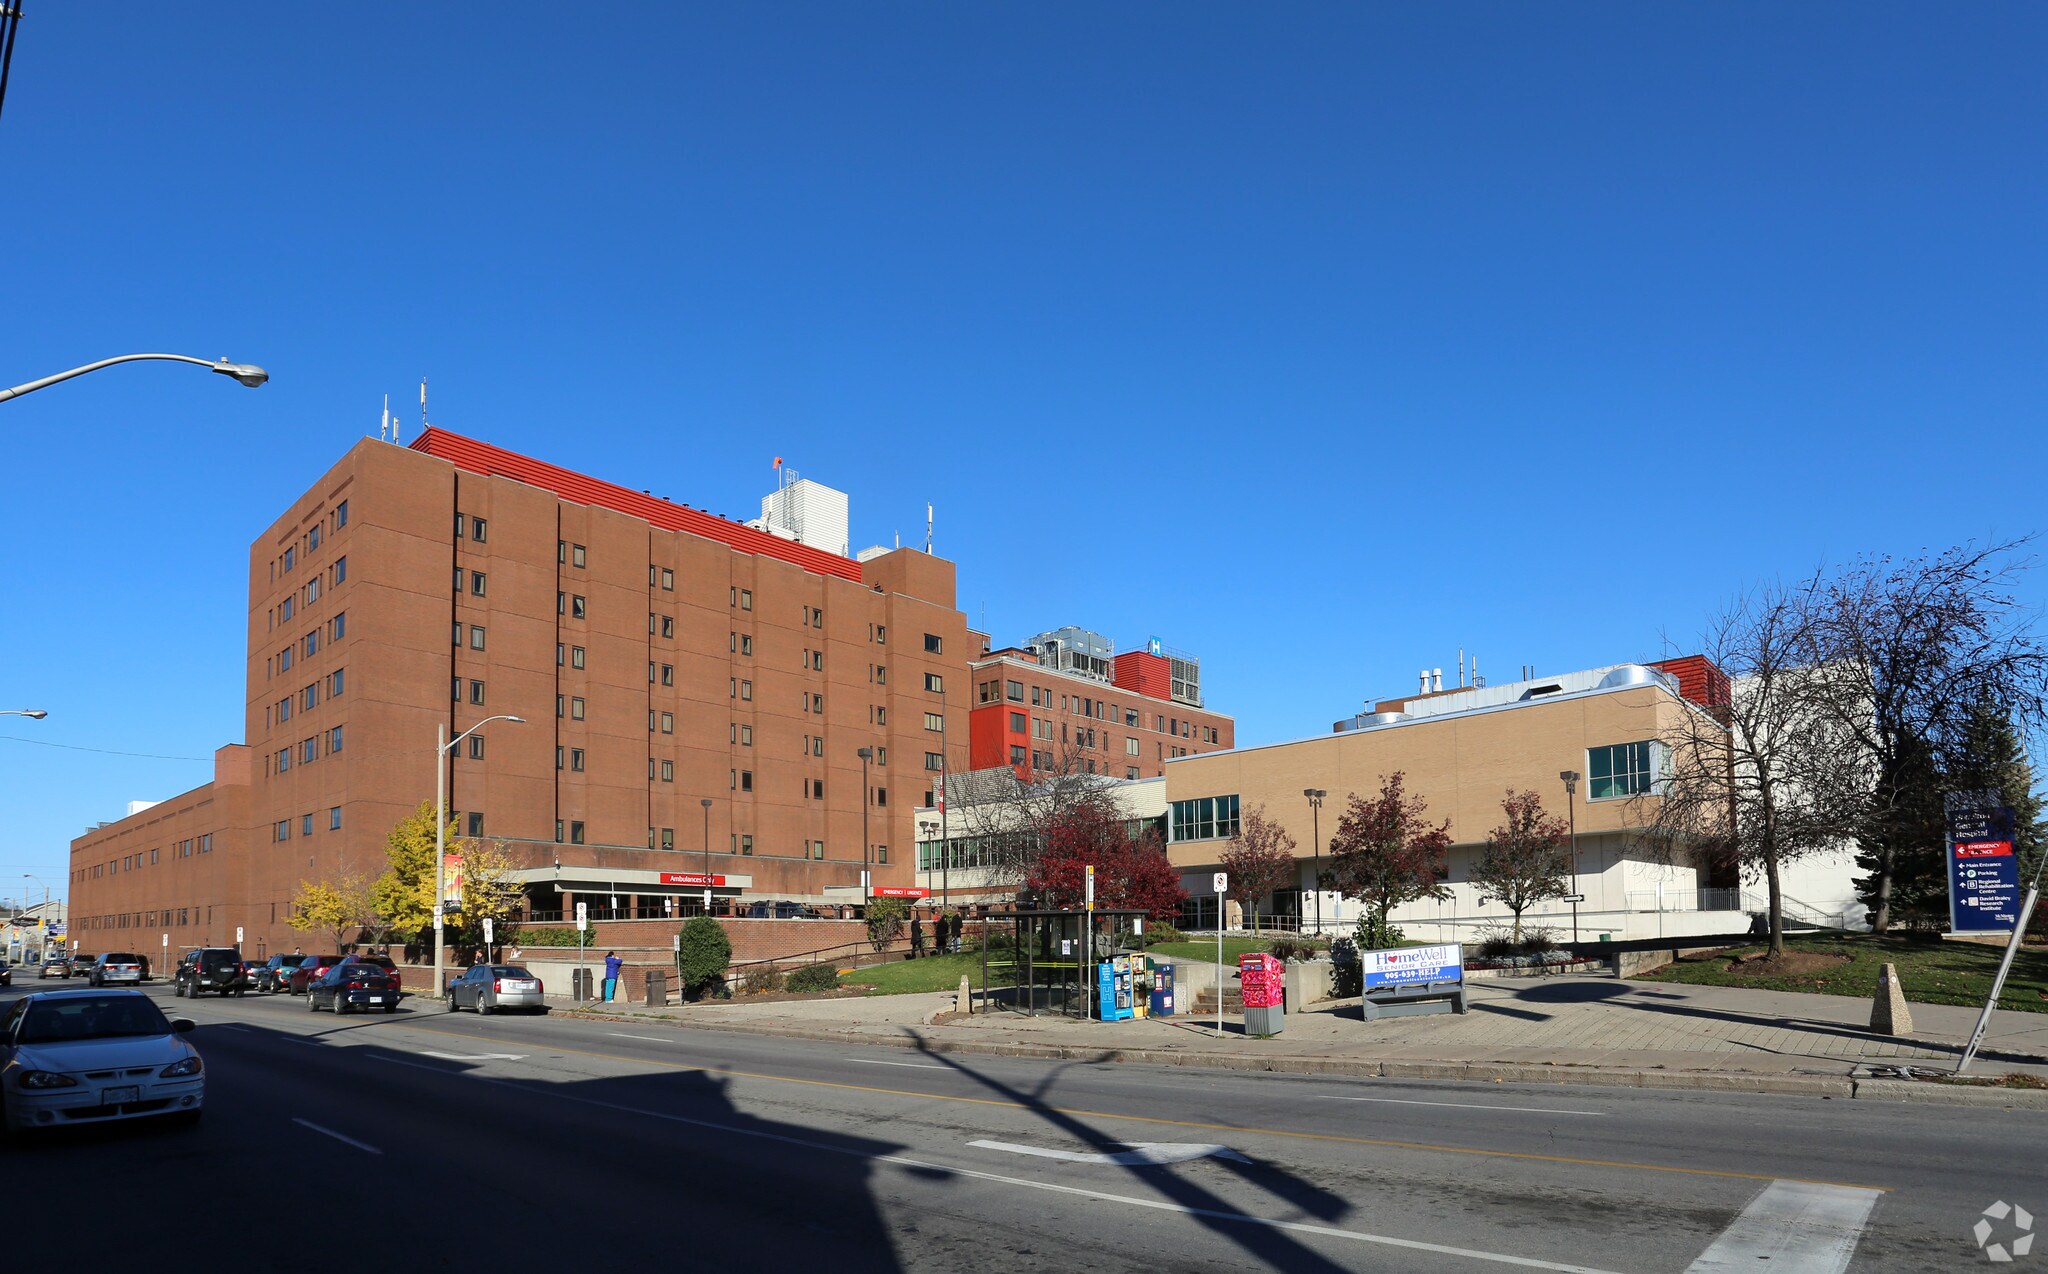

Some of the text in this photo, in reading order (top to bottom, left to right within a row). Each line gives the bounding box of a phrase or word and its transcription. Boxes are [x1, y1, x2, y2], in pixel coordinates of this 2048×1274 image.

[1152, 639, 1160, 654] H
[670, 875, 702, 883] Ambulances
[1376, 946, 1447, 965] HomeWell
[1376, 963, 1415, 971] SENIOR
[1385, 967, 1441, 979] 905-639-HELP
